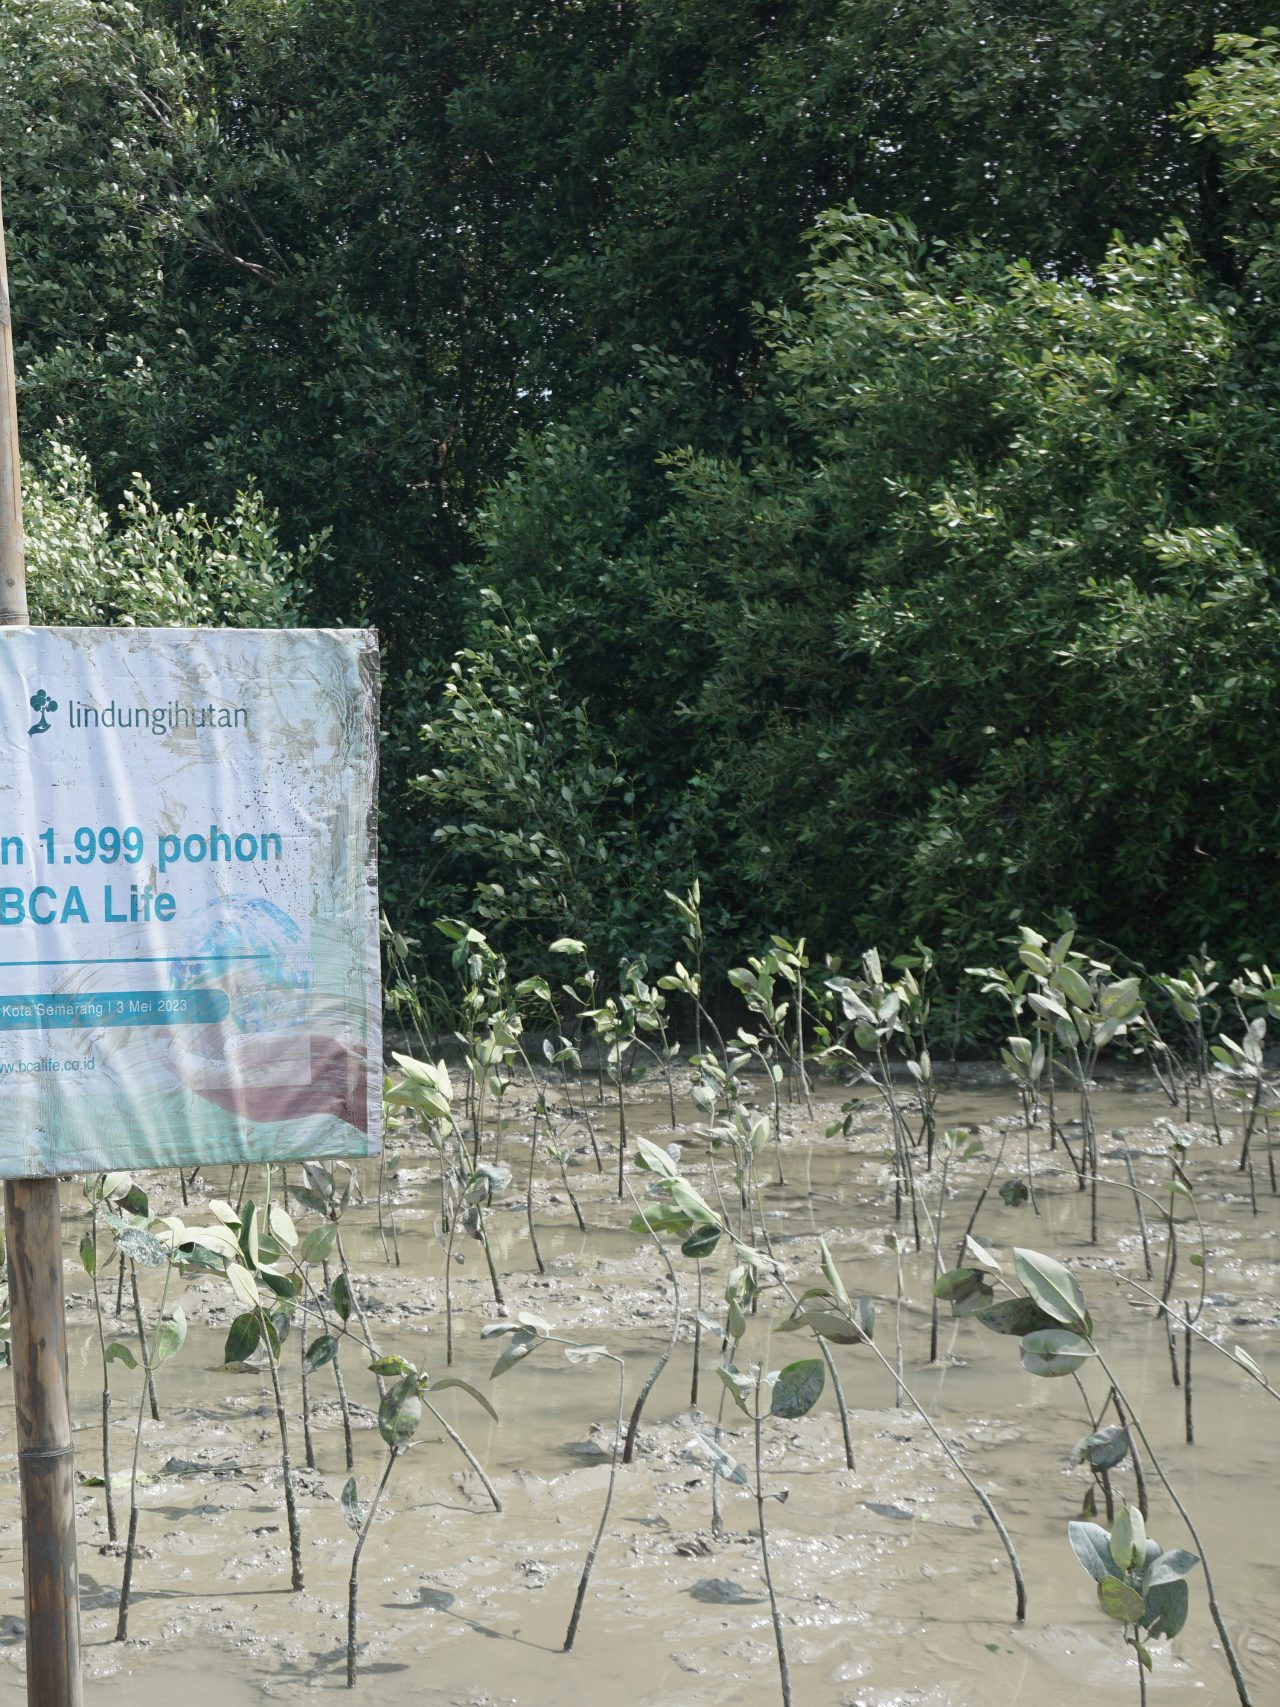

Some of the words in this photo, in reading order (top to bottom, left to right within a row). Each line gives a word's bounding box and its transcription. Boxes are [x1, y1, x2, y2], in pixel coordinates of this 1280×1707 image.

[68, 700, 249, 735] lindungihutan
[39, 826, 144, 866] 1.999
[157, 824, 283, 873] pohon
[103, 882, 177, 922] Life
[2, 1004, 33, 1018] Kota
[36, 1002, 104, 1018] Semarang
[116, 1001, 125, 1014] 3
[129, 999, 153, 1013] Mei
[157, 998, 188, 1013] 2023
